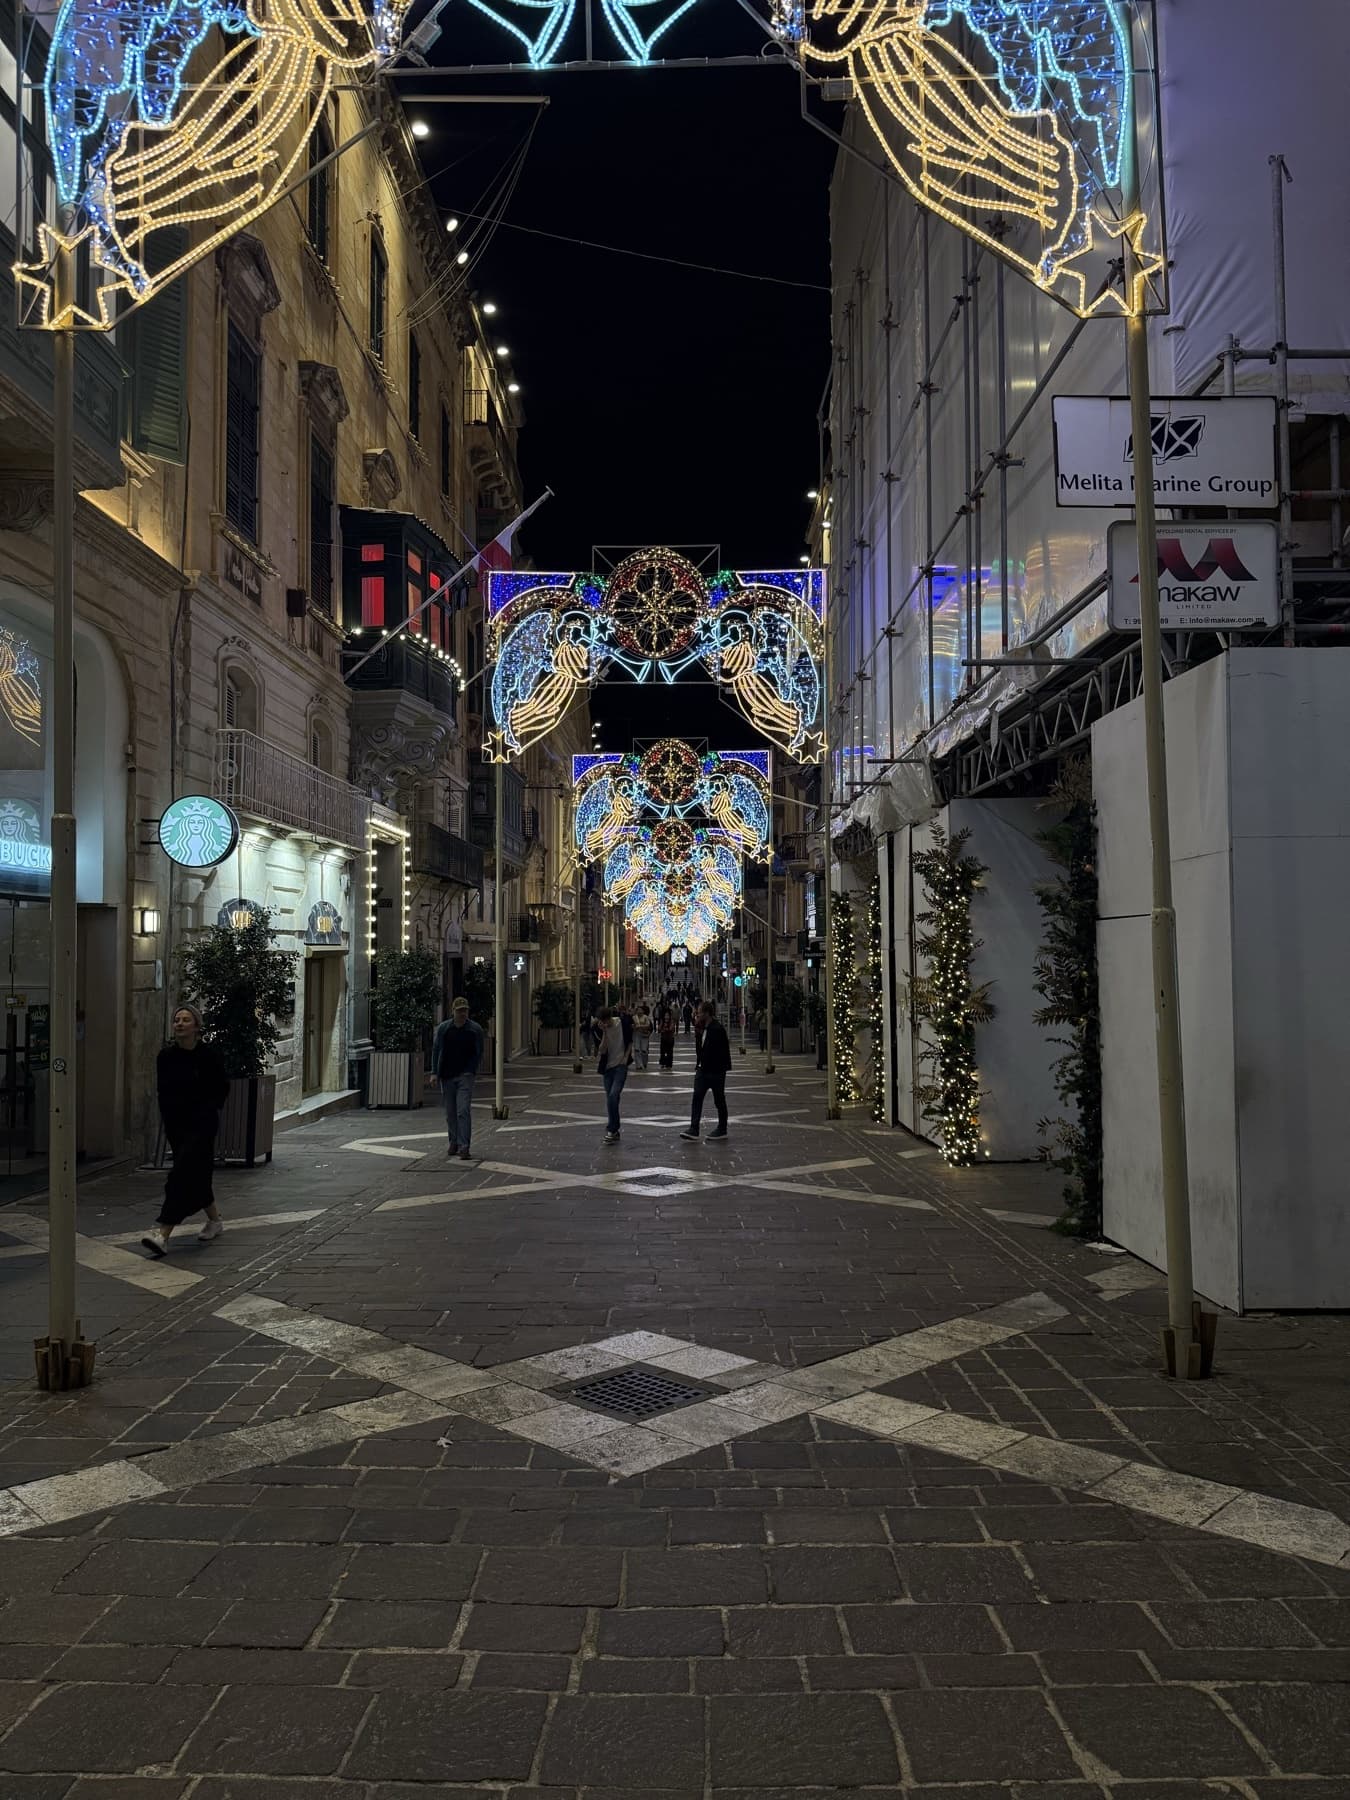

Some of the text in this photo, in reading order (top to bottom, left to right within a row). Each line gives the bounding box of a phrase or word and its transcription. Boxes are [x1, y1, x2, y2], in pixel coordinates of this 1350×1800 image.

[1060, 474, 1273, 498] Melita arine Group
